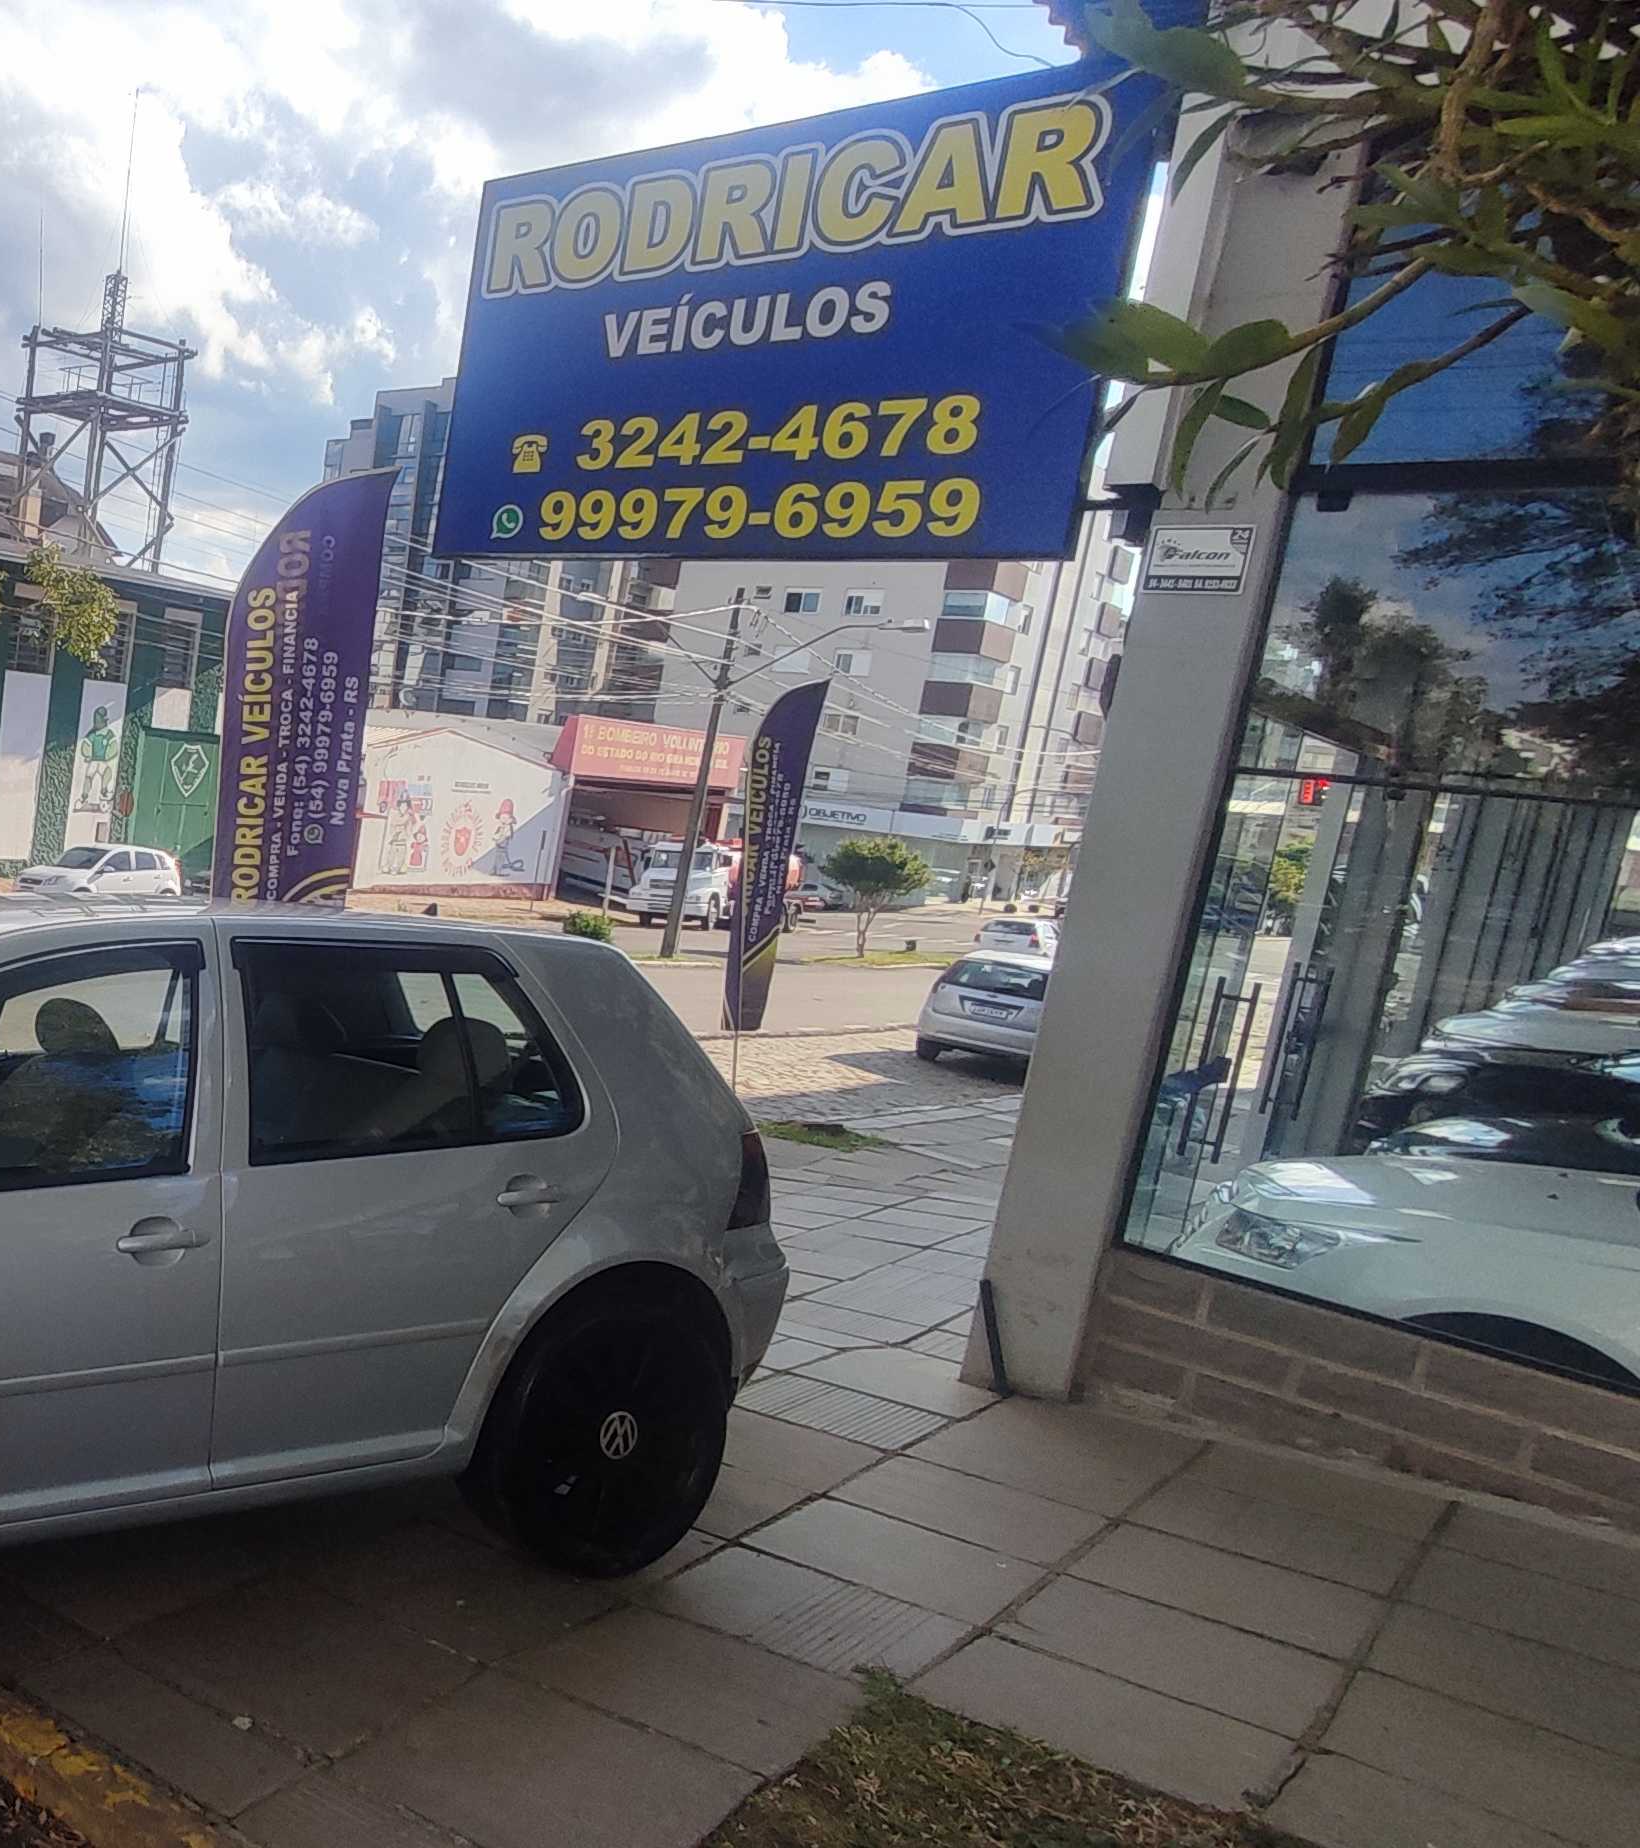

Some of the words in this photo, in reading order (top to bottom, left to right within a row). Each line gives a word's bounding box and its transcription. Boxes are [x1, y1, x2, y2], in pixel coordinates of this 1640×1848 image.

[482, 94, 1113, 298] RODRICAR
[603, 280, 892, 359] VEÍCULOS
[575, 394, 981, 471] 3242-4678
[537, 479, 982, 542] 99979-6959
[282, 590, 300, 674] FINANCIA
[238, 587, 276, 745] VEÍCULOS
[297, 637, 319, 748] 3242-4678
[344, 677, 359, 703] RS
[278, 688, 294, 747] TROCA
[312, 651, 338, 773] 99979-6959
[598, 725, 657, 747] BOMBEIRO
[292, 755, 313, 795] (54)
[336, 721, 356, 772] Prata
[272, 762, 289, 819] VENDA
[307, 779, 329, 819] (54)
[330, 778, 349, 825] Nova
[808, 807, 867, 822] OBJETIVO
[231, 755, 269, 905] RODRICAR
[287, 801, 304, 857] Fone:
[266, 831, 282, 902] COMPRA
[748, 896, 764, 942] COMPRA
